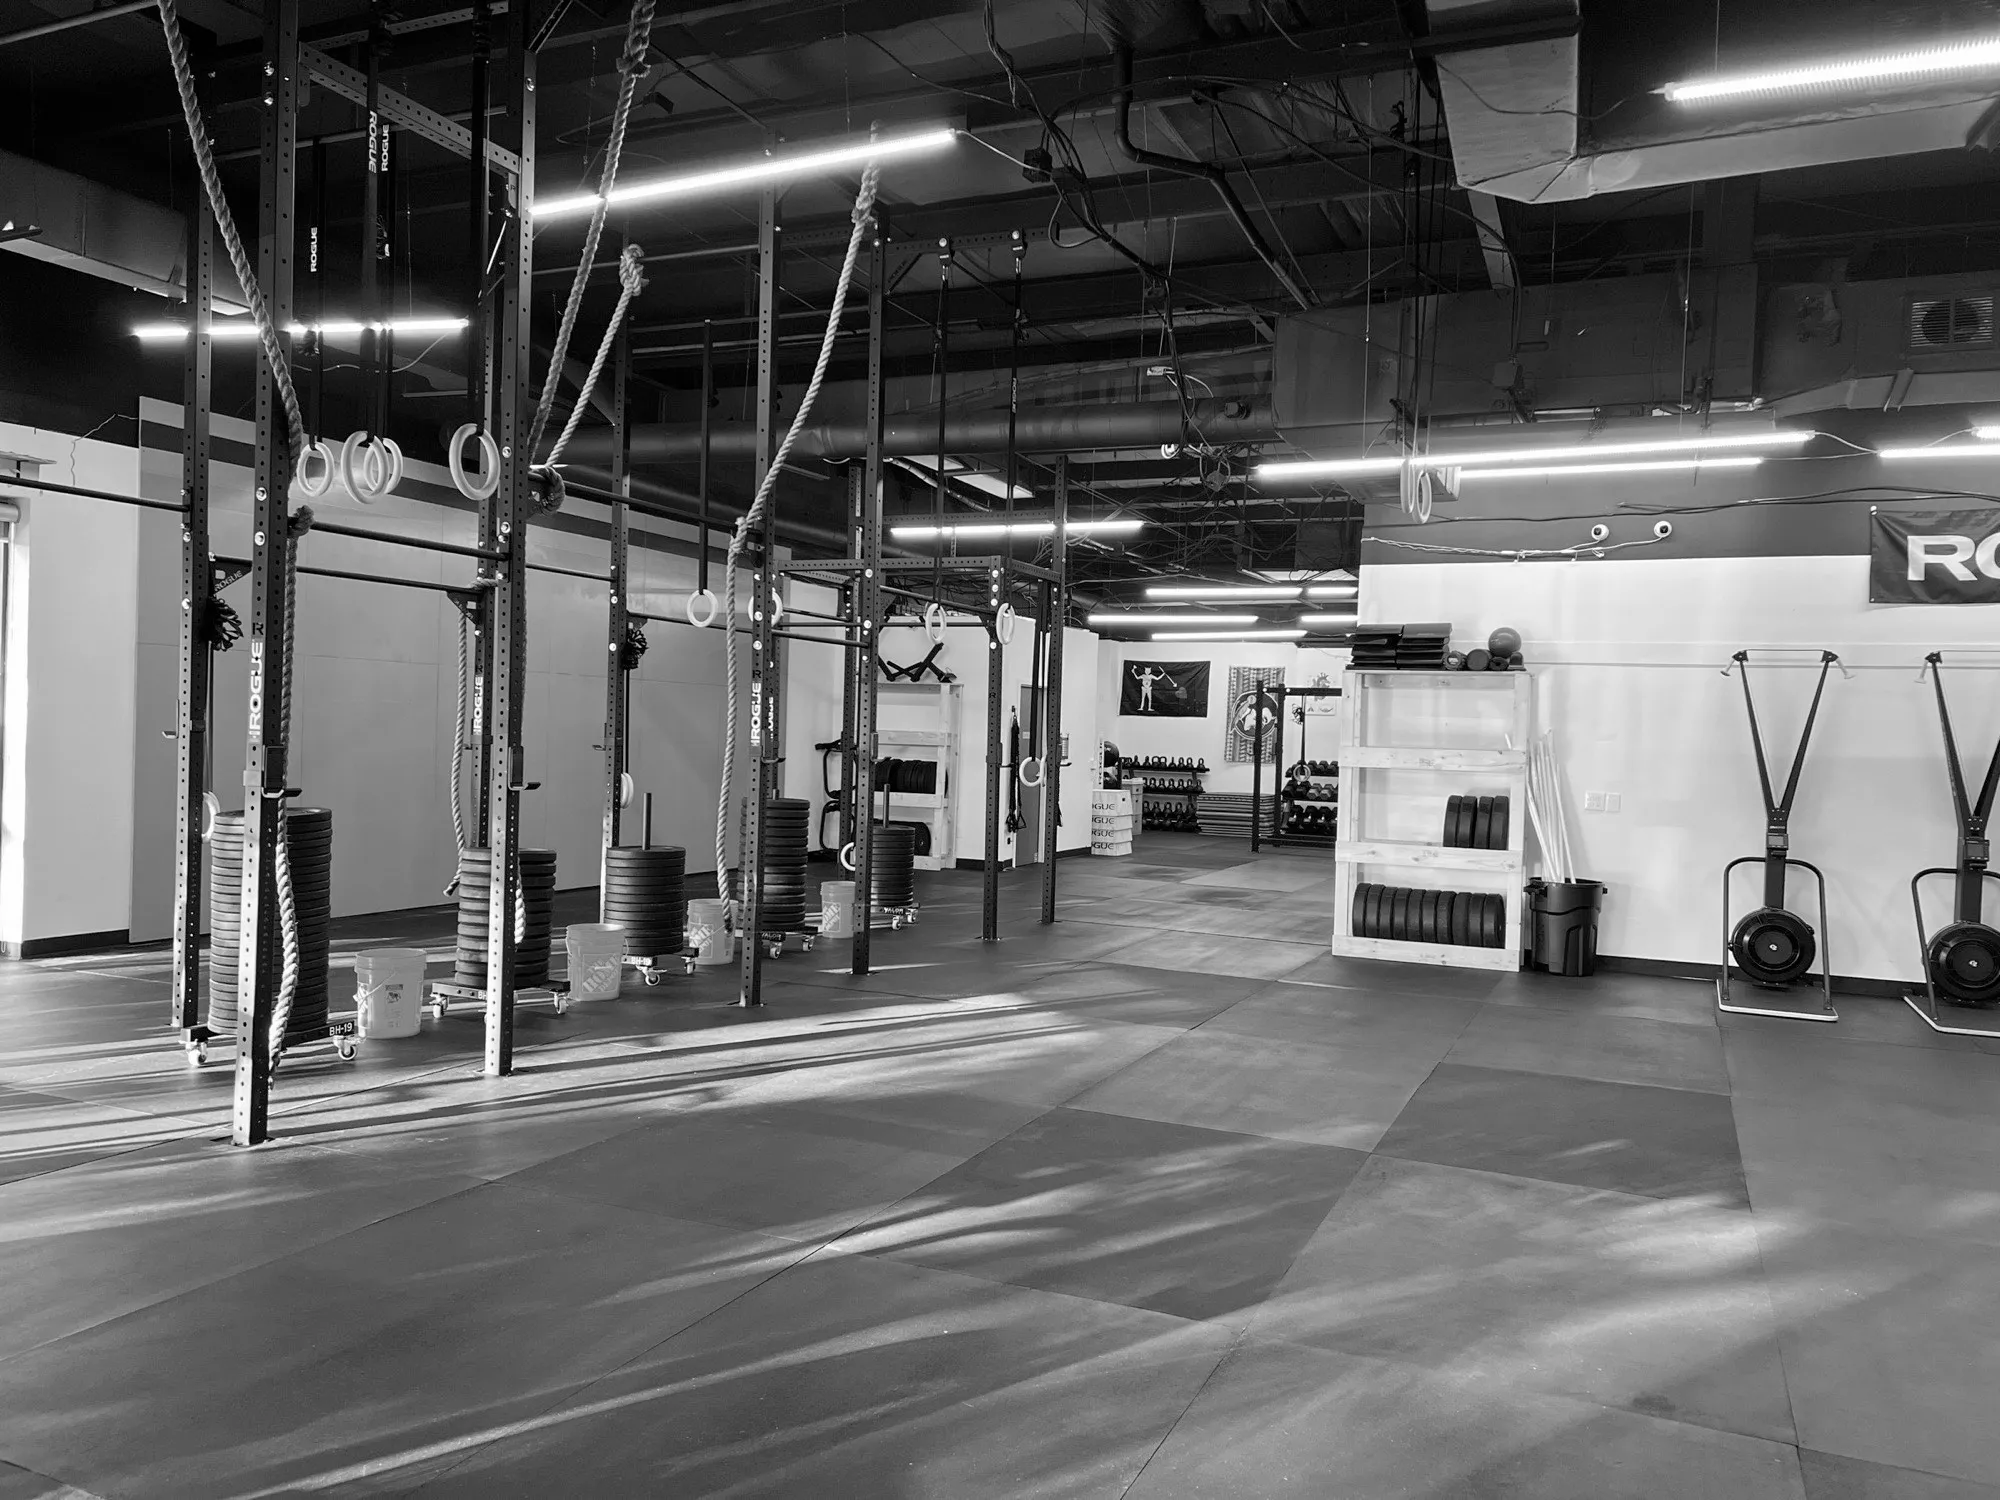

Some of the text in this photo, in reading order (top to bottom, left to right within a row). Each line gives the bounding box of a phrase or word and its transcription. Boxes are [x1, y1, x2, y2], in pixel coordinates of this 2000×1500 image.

[368, 110, 378, 173] ROGUE
[381, 124, 390, 172] ROGUE
[310, 227, 318, 272] ROGUE
[214, 570, 243, 592] ROGUE
[249, 642, 263, 730] ROGUE
[473, 676, 484, 728] ROGUE
[750, 682, 762, 740] ROGUE
[329, 1022, 353, 1036] BH-19
